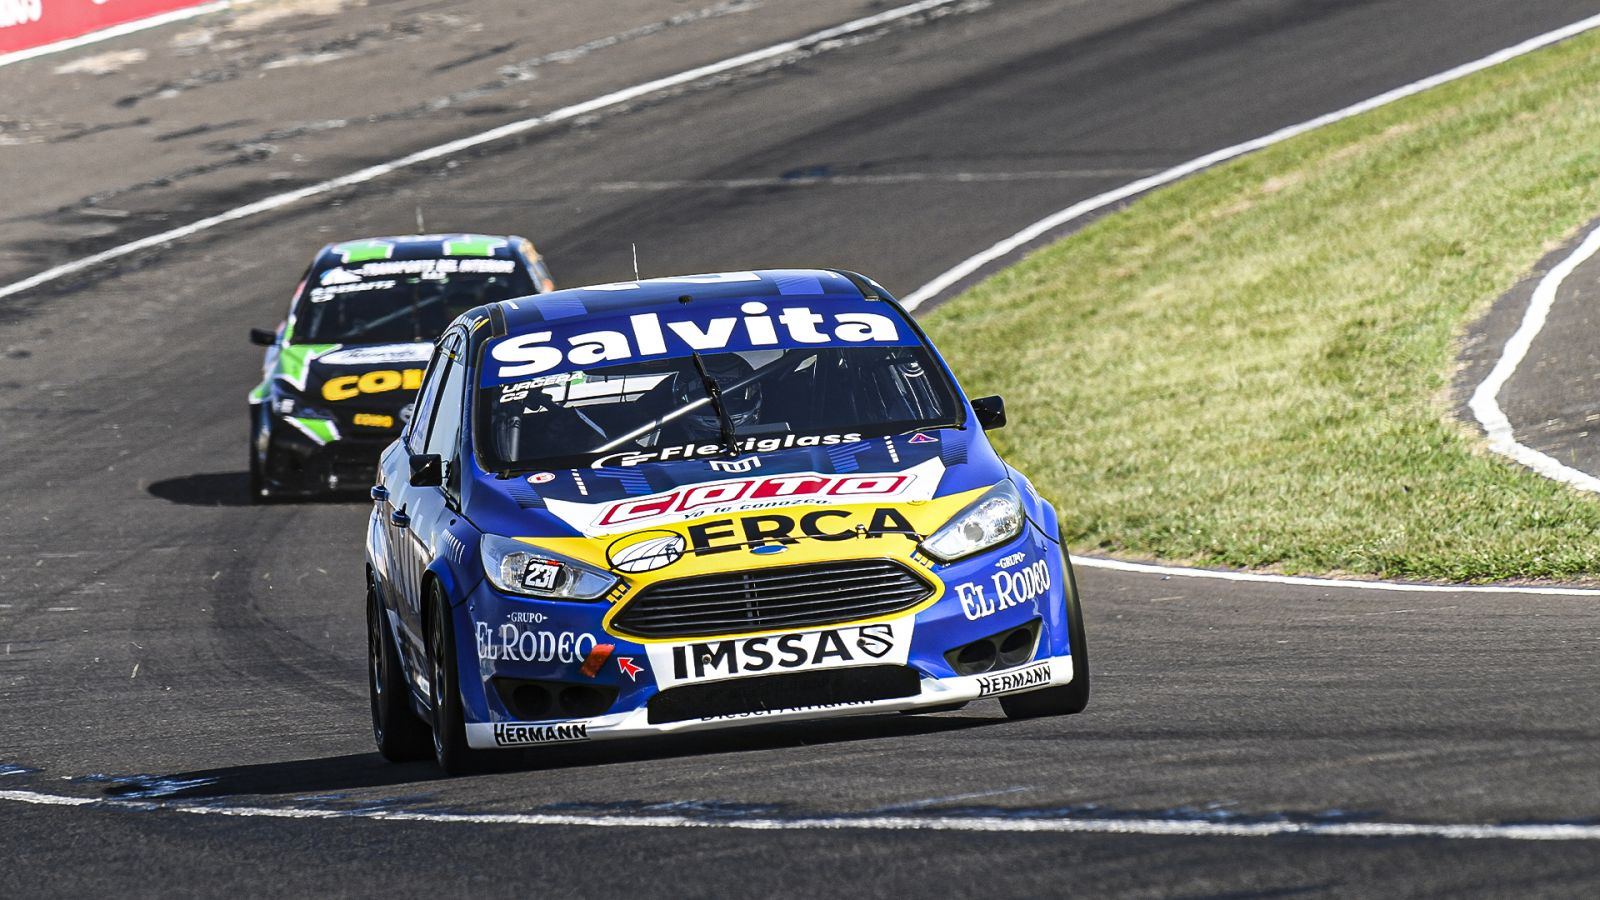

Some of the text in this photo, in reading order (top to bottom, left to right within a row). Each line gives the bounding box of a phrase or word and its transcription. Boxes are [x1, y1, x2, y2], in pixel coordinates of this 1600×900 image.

[491, 301, 899, 378] Salvita
[598, 475, 907, 526] COTO
[688, 508, 917, 557] ERCA
[525, 563, 560, 589] 231
[1000, 552, 1024, 568] GRUPO
[955, 559, 1051, 620] EL RODEO
[511, 611, 543, 623] GRUPO
[475, 621, 598, 664] EL RODEO
[673, 629, 854, 680] IMSSA
[976, 665, 1051, 698] HERMANN
[494, 723, 588, 746] HERMANN
